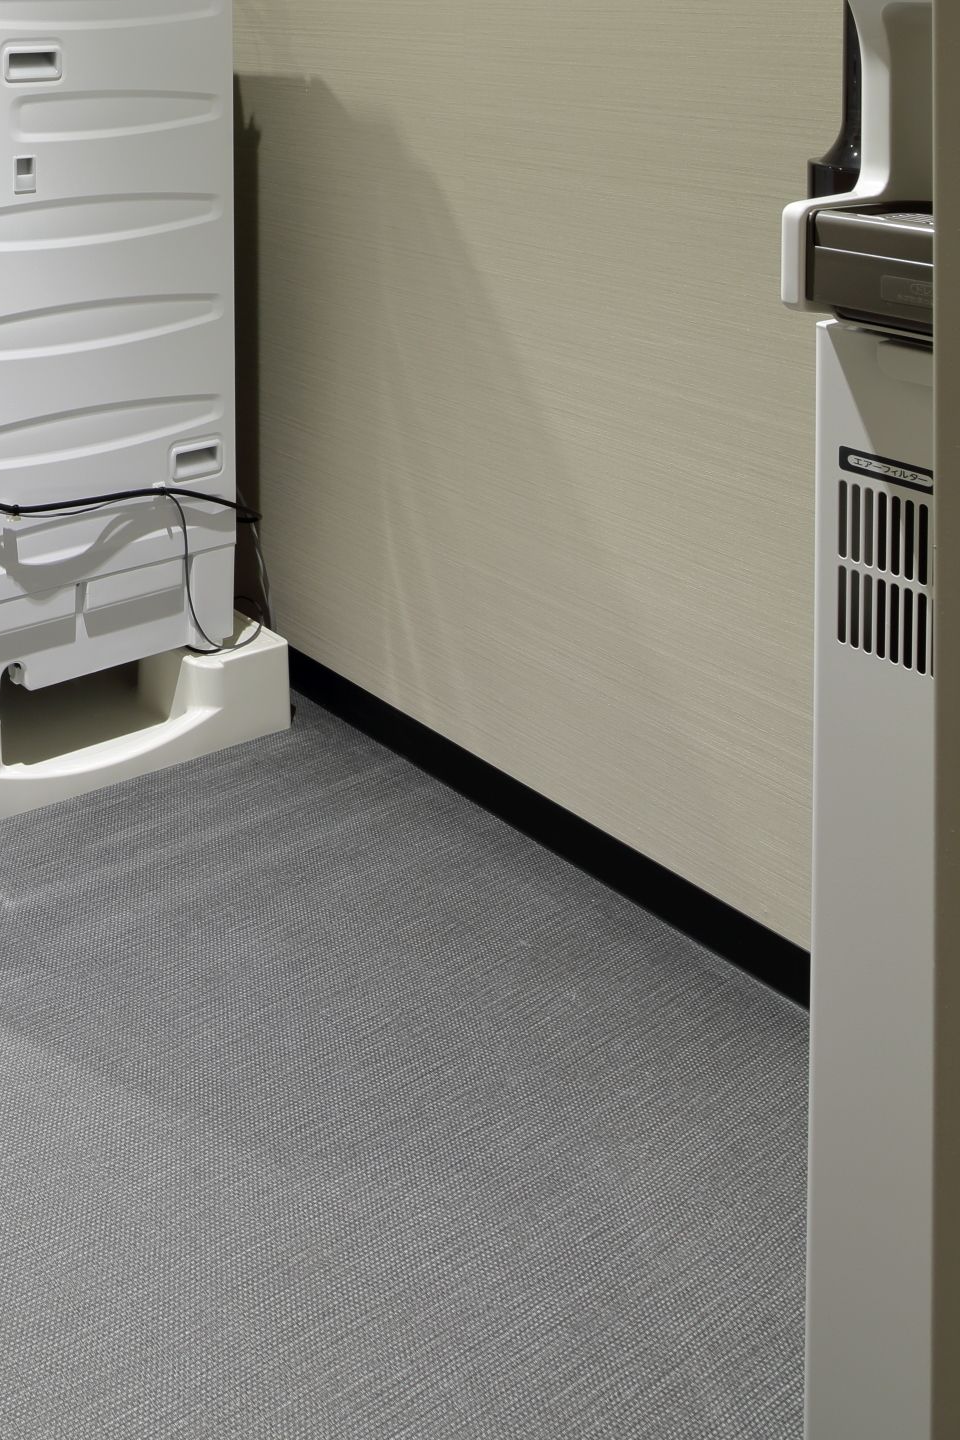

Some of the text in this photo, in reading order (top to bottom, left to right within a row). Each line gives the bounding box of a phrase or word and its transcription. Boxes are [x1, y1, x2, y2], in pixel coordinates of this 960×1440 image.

[852, 457, 928, 482] エアーフィルター
